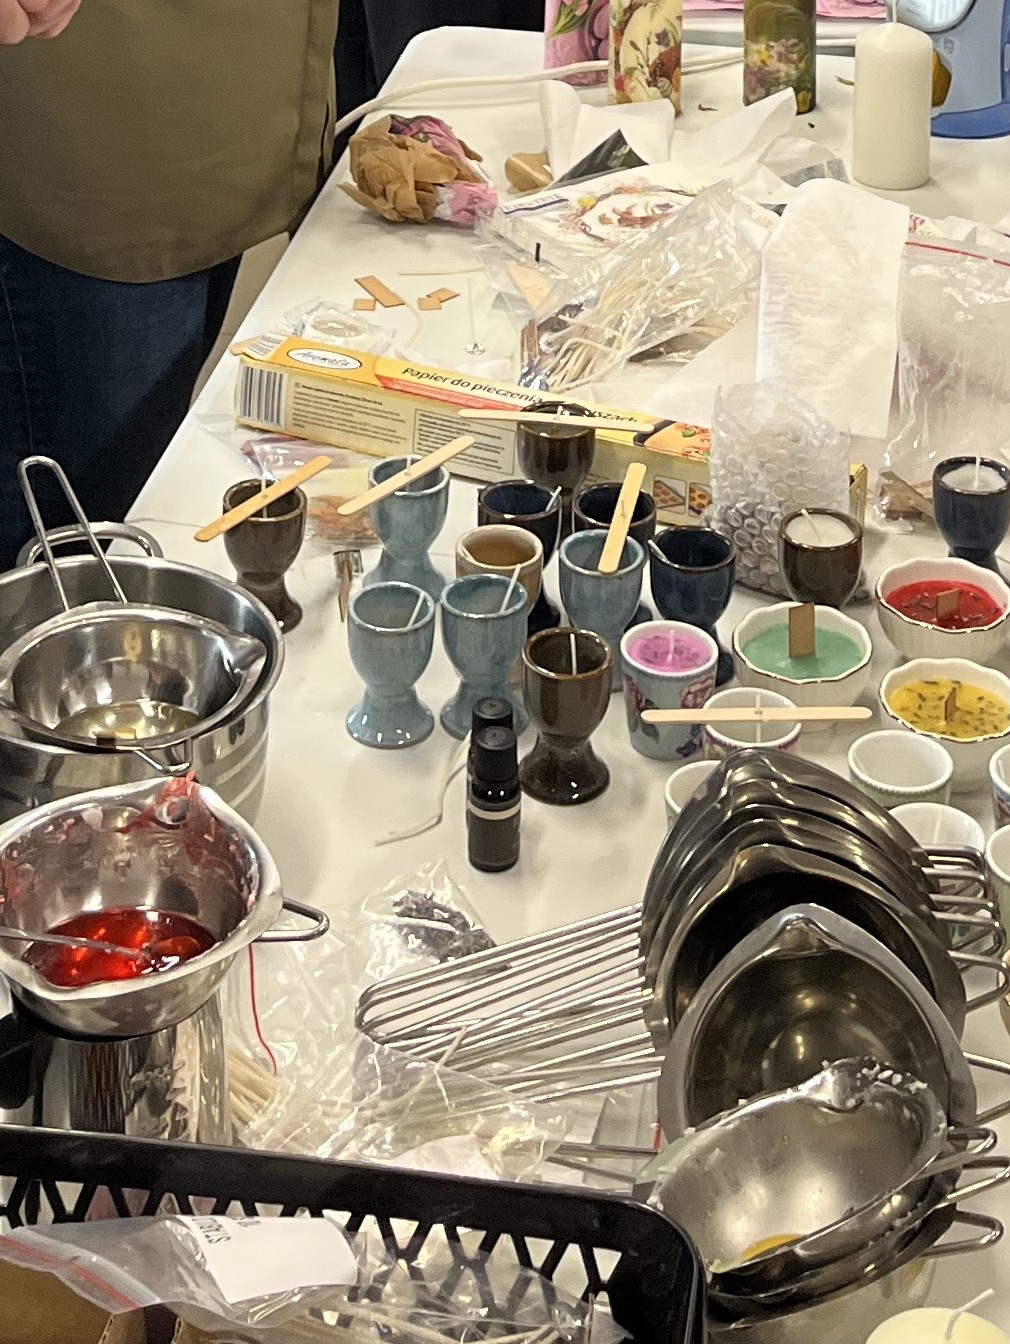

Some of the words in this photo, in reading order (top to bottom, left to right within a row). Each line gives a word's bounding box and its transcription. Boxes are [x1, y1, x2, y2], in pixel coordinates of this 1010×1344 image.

[401, 367, 450, 383] Papier
[450, 378, 471, 388] do
[470, 383, 543, 404] pieczenia
